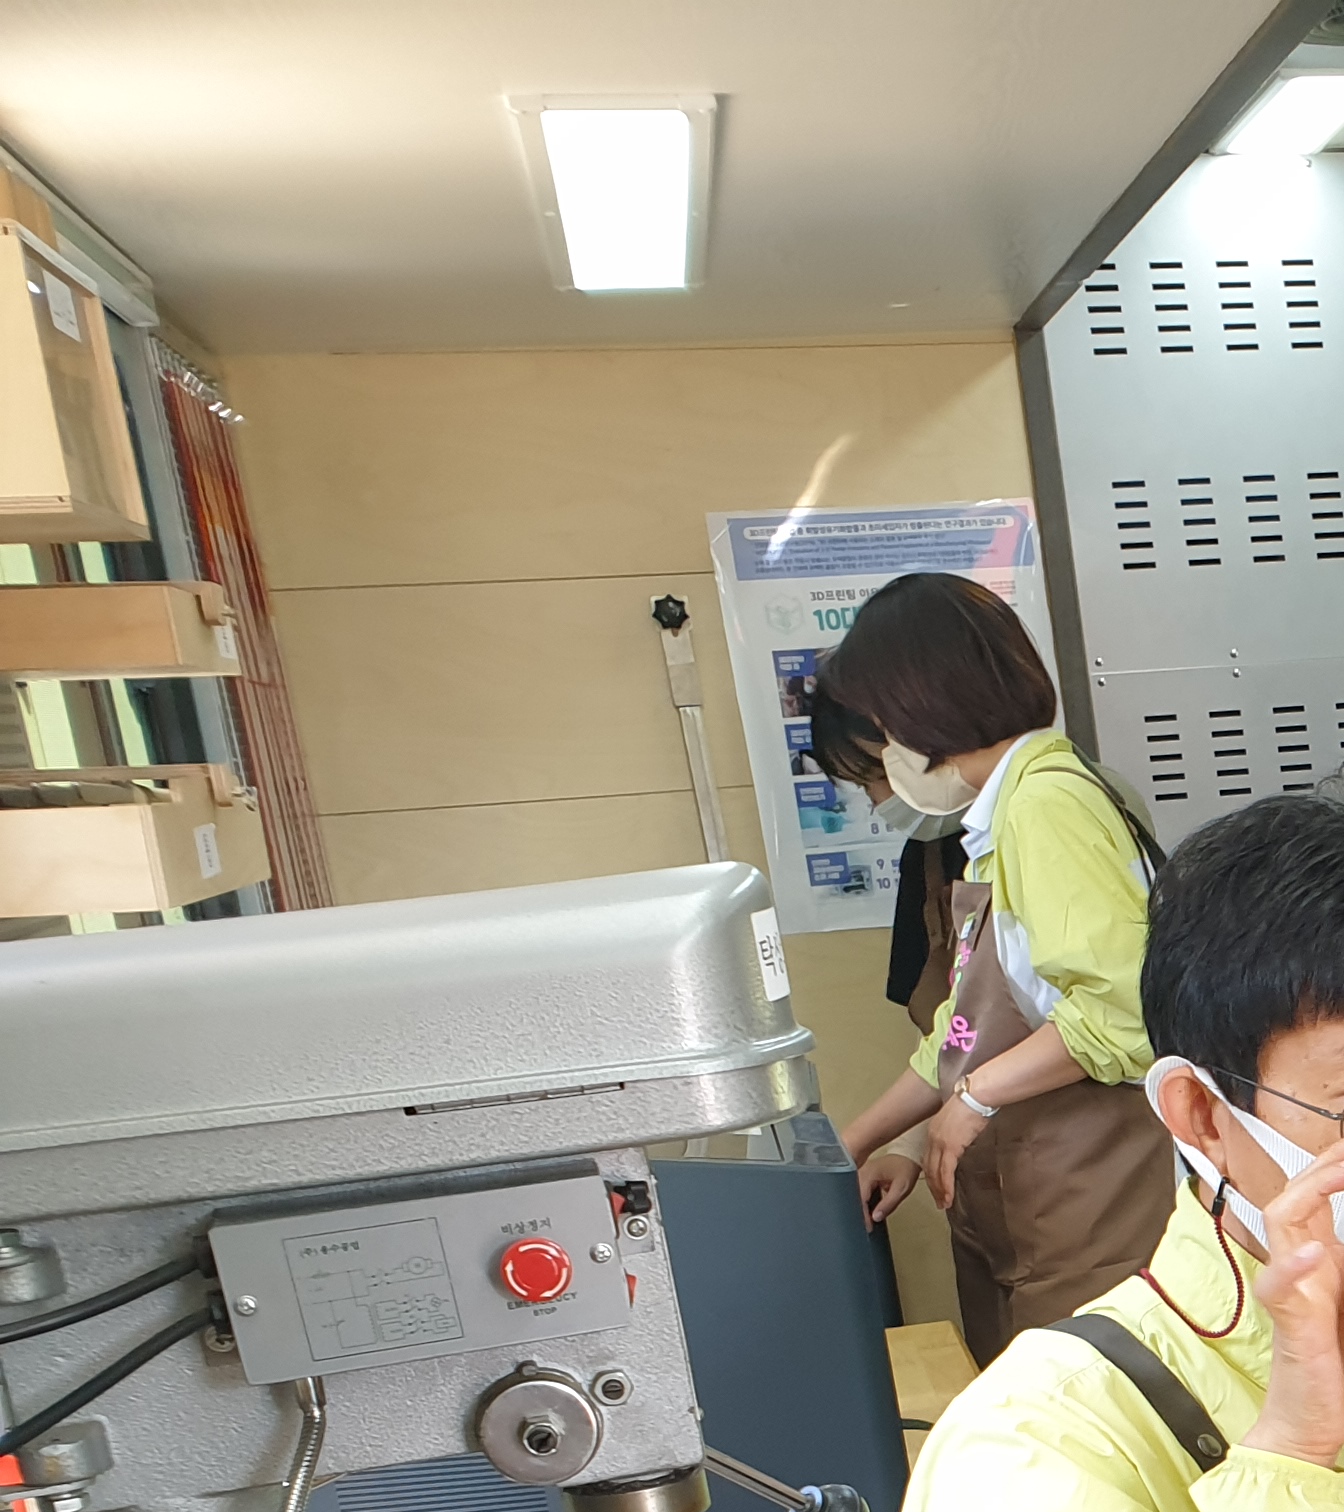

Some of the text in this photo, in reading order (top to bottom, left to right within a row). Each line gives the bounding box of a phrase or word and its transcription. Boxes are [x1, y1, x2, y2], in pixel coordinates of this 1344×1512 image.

[810, 588, 857, 602] 3D프린팅
[876, 858, 885, 870] 9
[876, 877, 891, 889] 10
[501, 1217, 552, 1235] 비상정지
[533, 1306, 558, 1317] STOP
